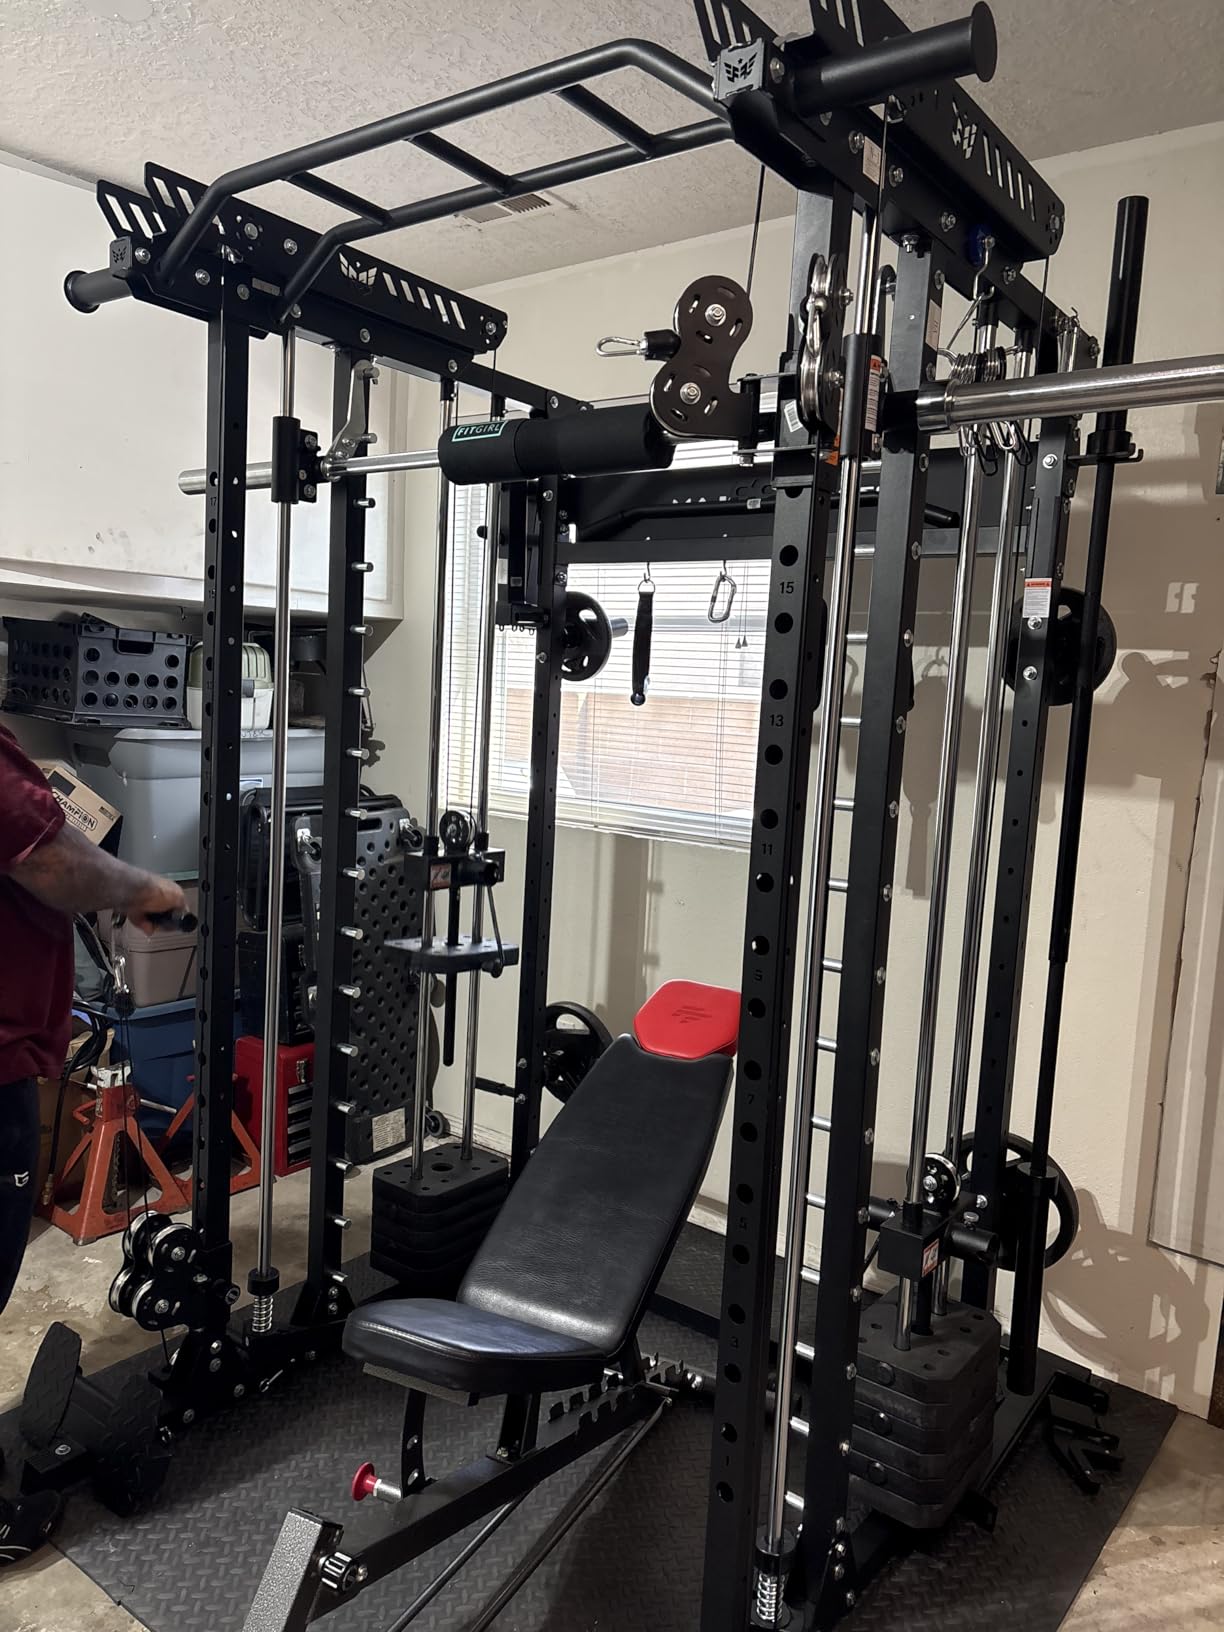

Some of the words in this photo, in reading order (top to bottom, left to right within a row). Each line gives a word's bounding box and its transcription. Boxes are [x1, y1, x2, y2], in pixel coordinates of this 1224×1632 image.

[457, 424, 500, 436] FITGIRL
[780, 582, 794, 594] 15
[770, 714, 784, 727] 13
[762, 843, 773, 856] 11
[746, 1093, 755, 1105] 7
